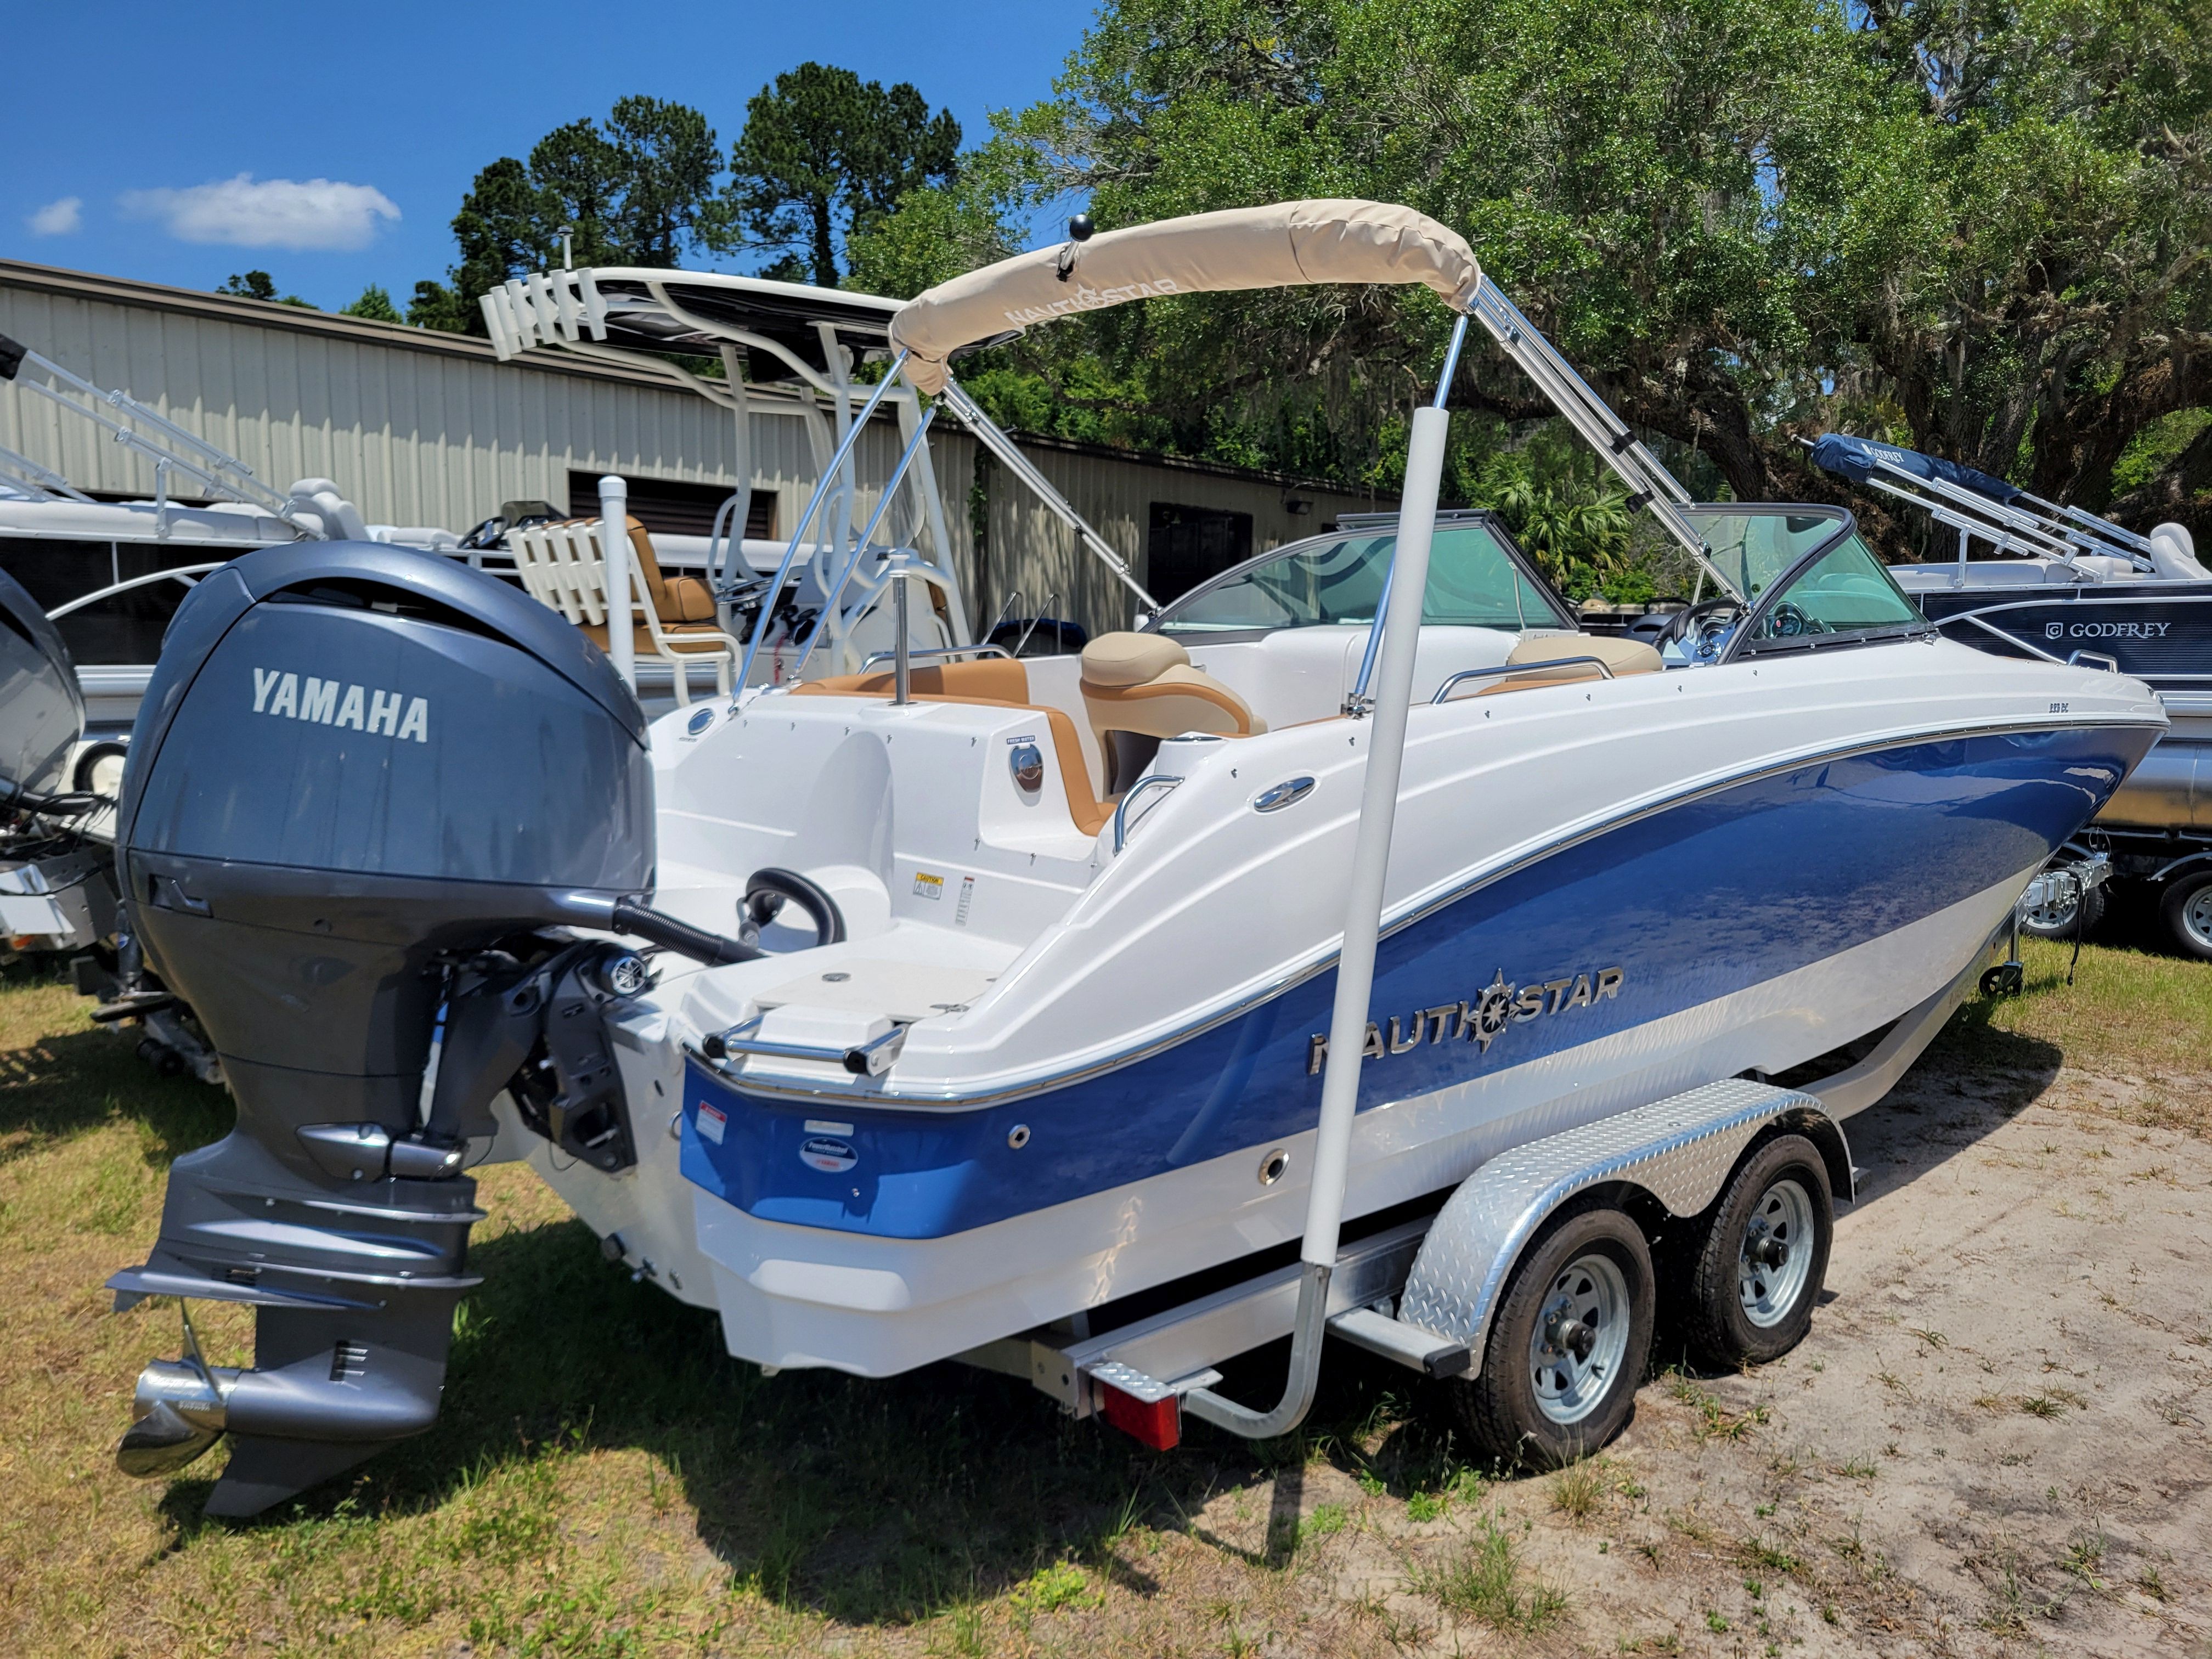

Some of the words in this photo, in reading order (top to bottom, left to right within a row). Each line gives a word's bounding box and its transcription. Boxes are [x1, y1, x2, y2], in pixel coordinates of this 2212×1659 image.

[1870, 447, 1904, 463] GODFREY
[2070, 623, 2171, 639] GODFREY
[253, 667, 428, 743] YAMAHA
[921, 874, 939, 883] CAUTION
